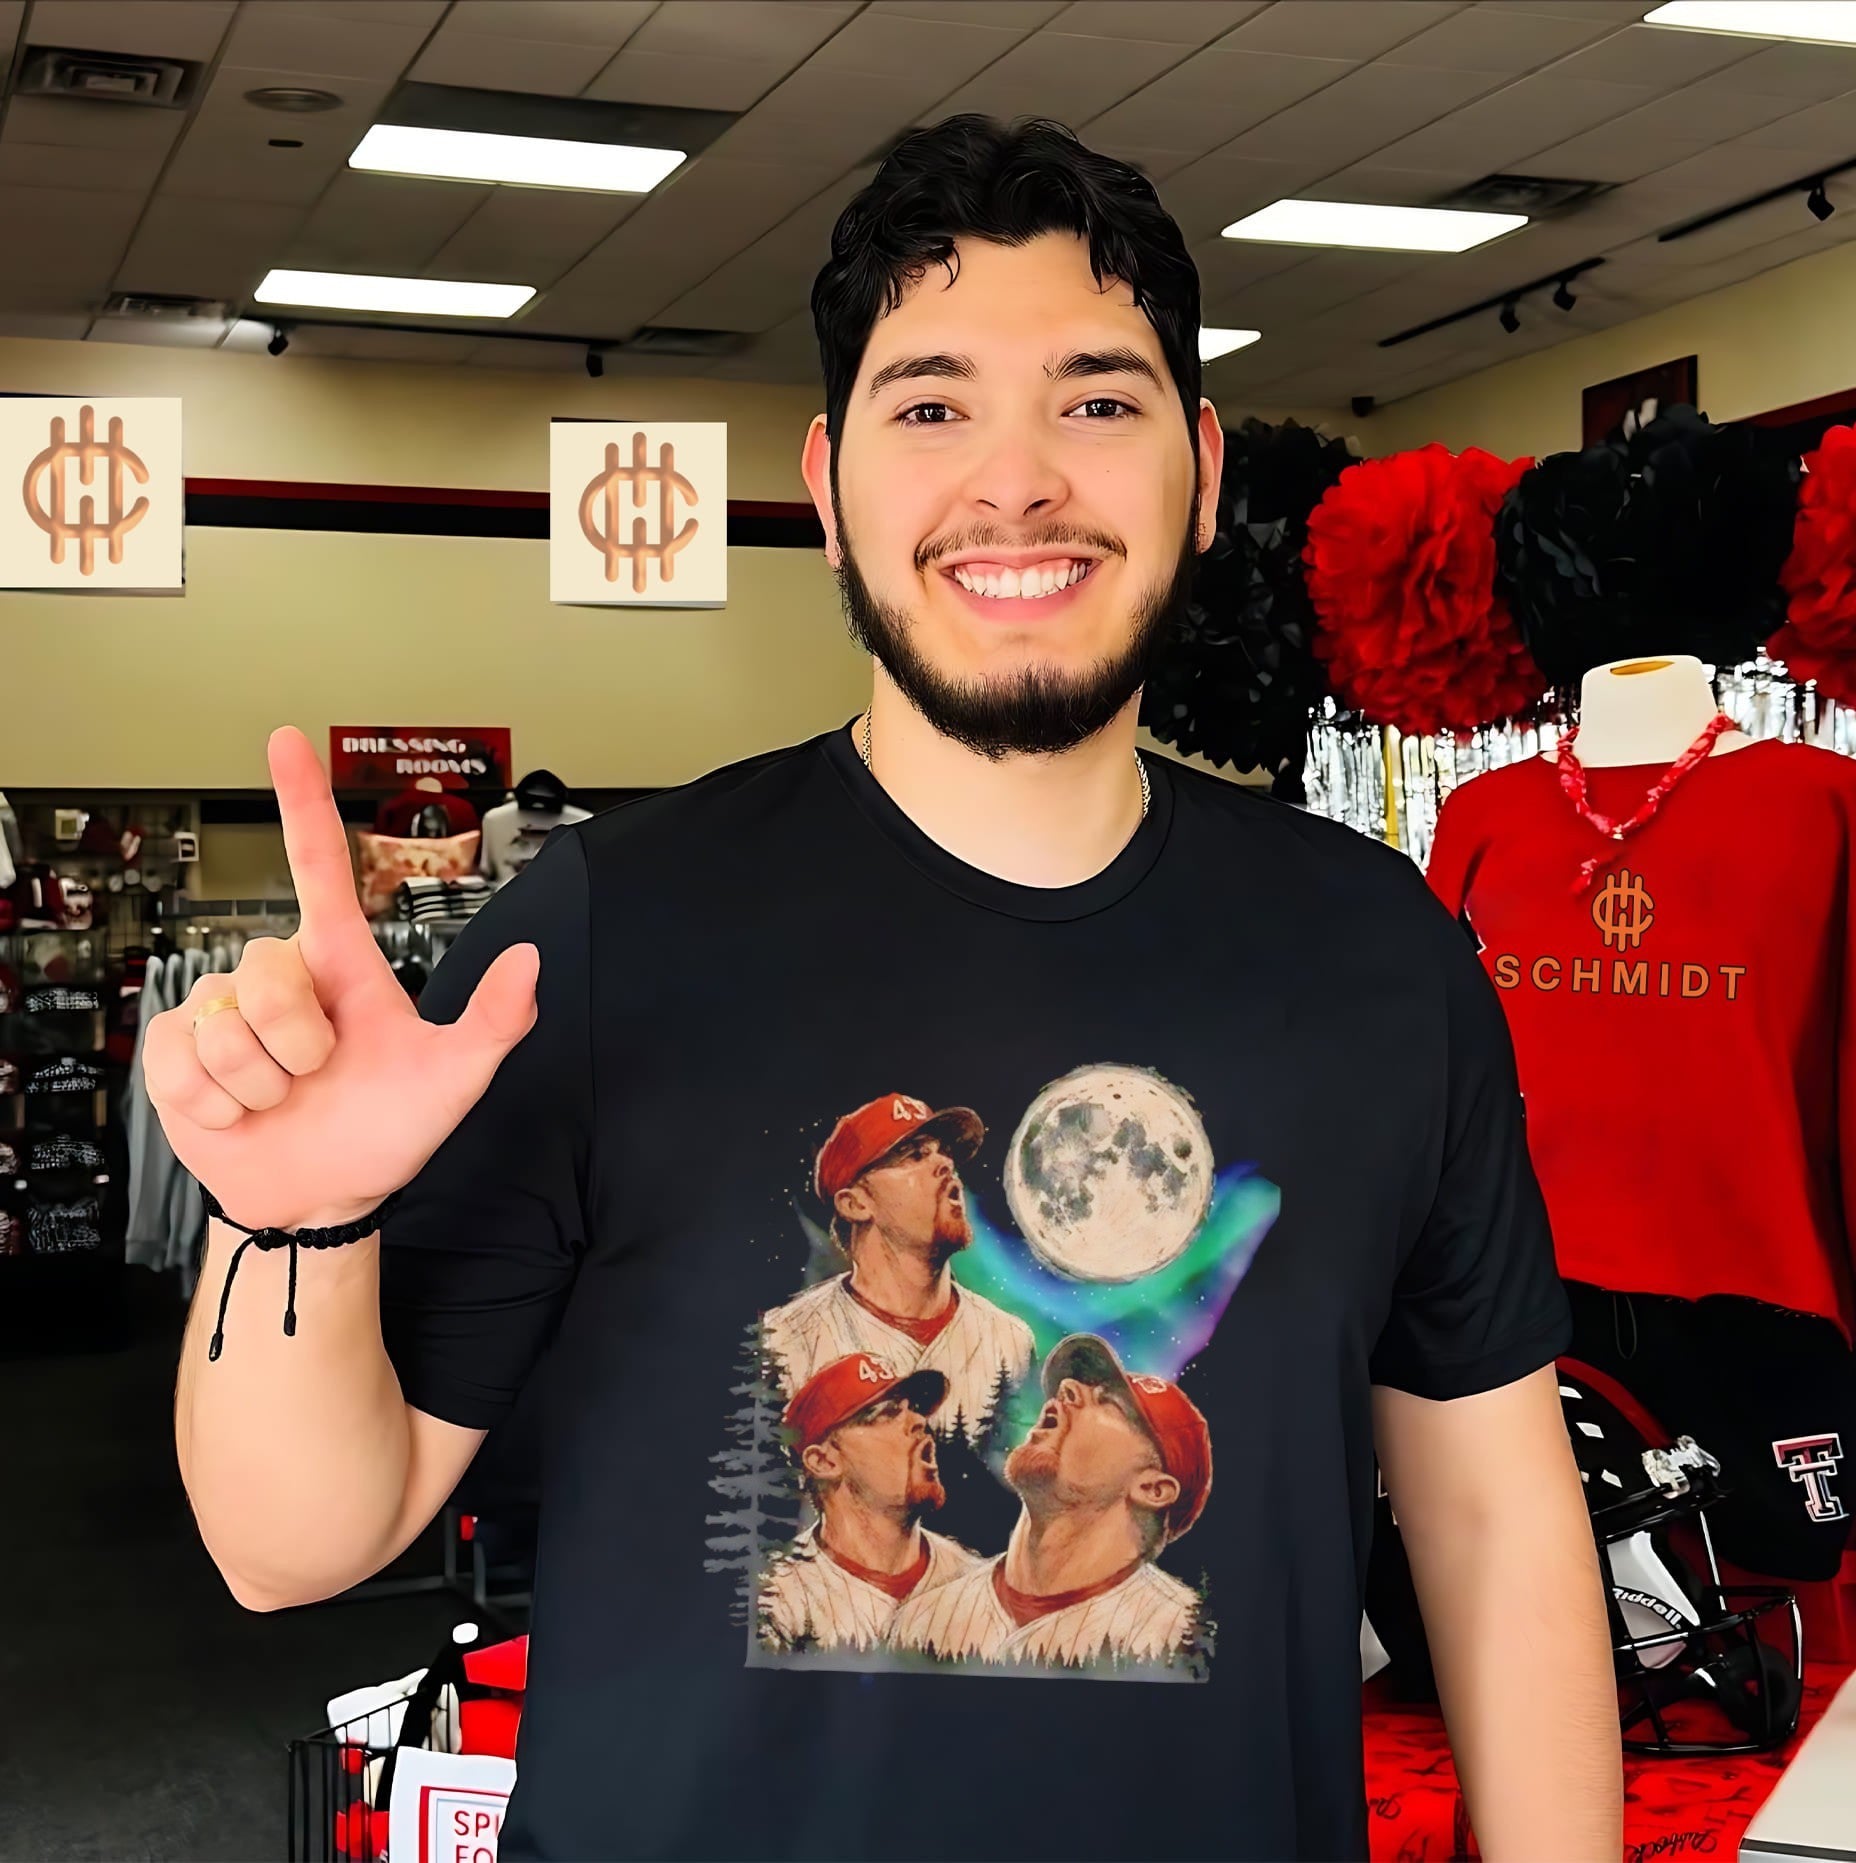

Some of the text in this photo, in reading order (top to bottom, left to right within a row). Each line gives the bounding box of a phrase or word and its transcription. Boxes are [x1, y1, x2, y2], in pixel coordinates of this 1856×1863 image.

[342, 737, 467, 754] DRESSING
[396, 758, 487, 774] ROOMS
[1494, 953, 1747, 1001] SCHMIDT
